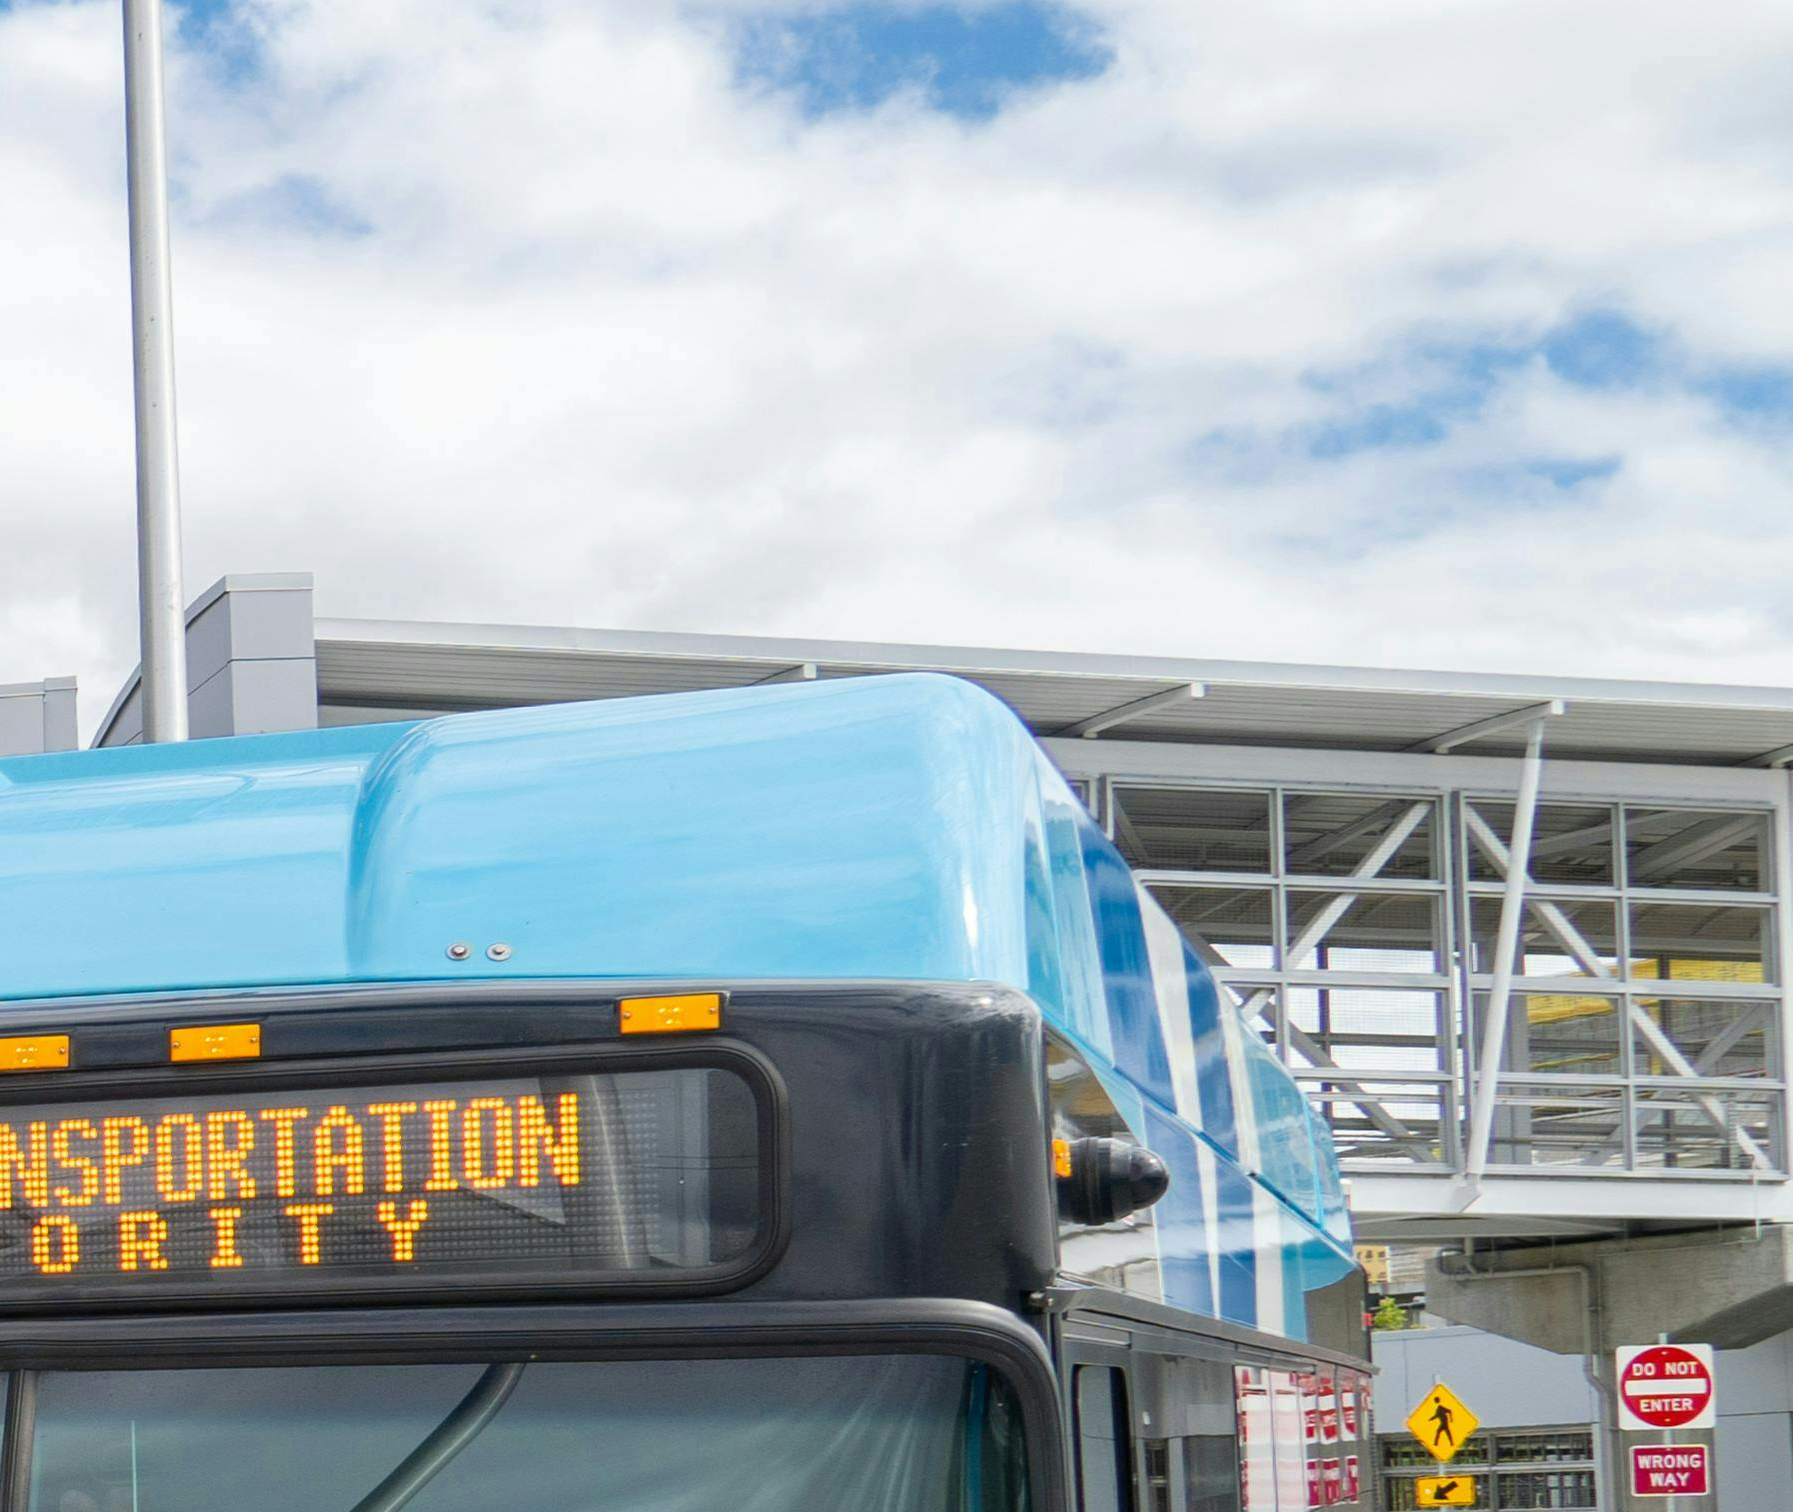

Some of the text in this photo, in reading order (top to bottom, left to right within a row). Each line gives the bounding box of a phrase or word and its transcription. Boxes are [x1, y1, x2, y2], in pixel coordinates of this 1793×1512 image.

[1632, 1361, 1698, 1376] DO NOT
[1639, 1398, 1694, 1412] ENTER
[1637, 1454, 1702, 1469] WRONG
[1649, 1472, 1690, 1487] WAY
